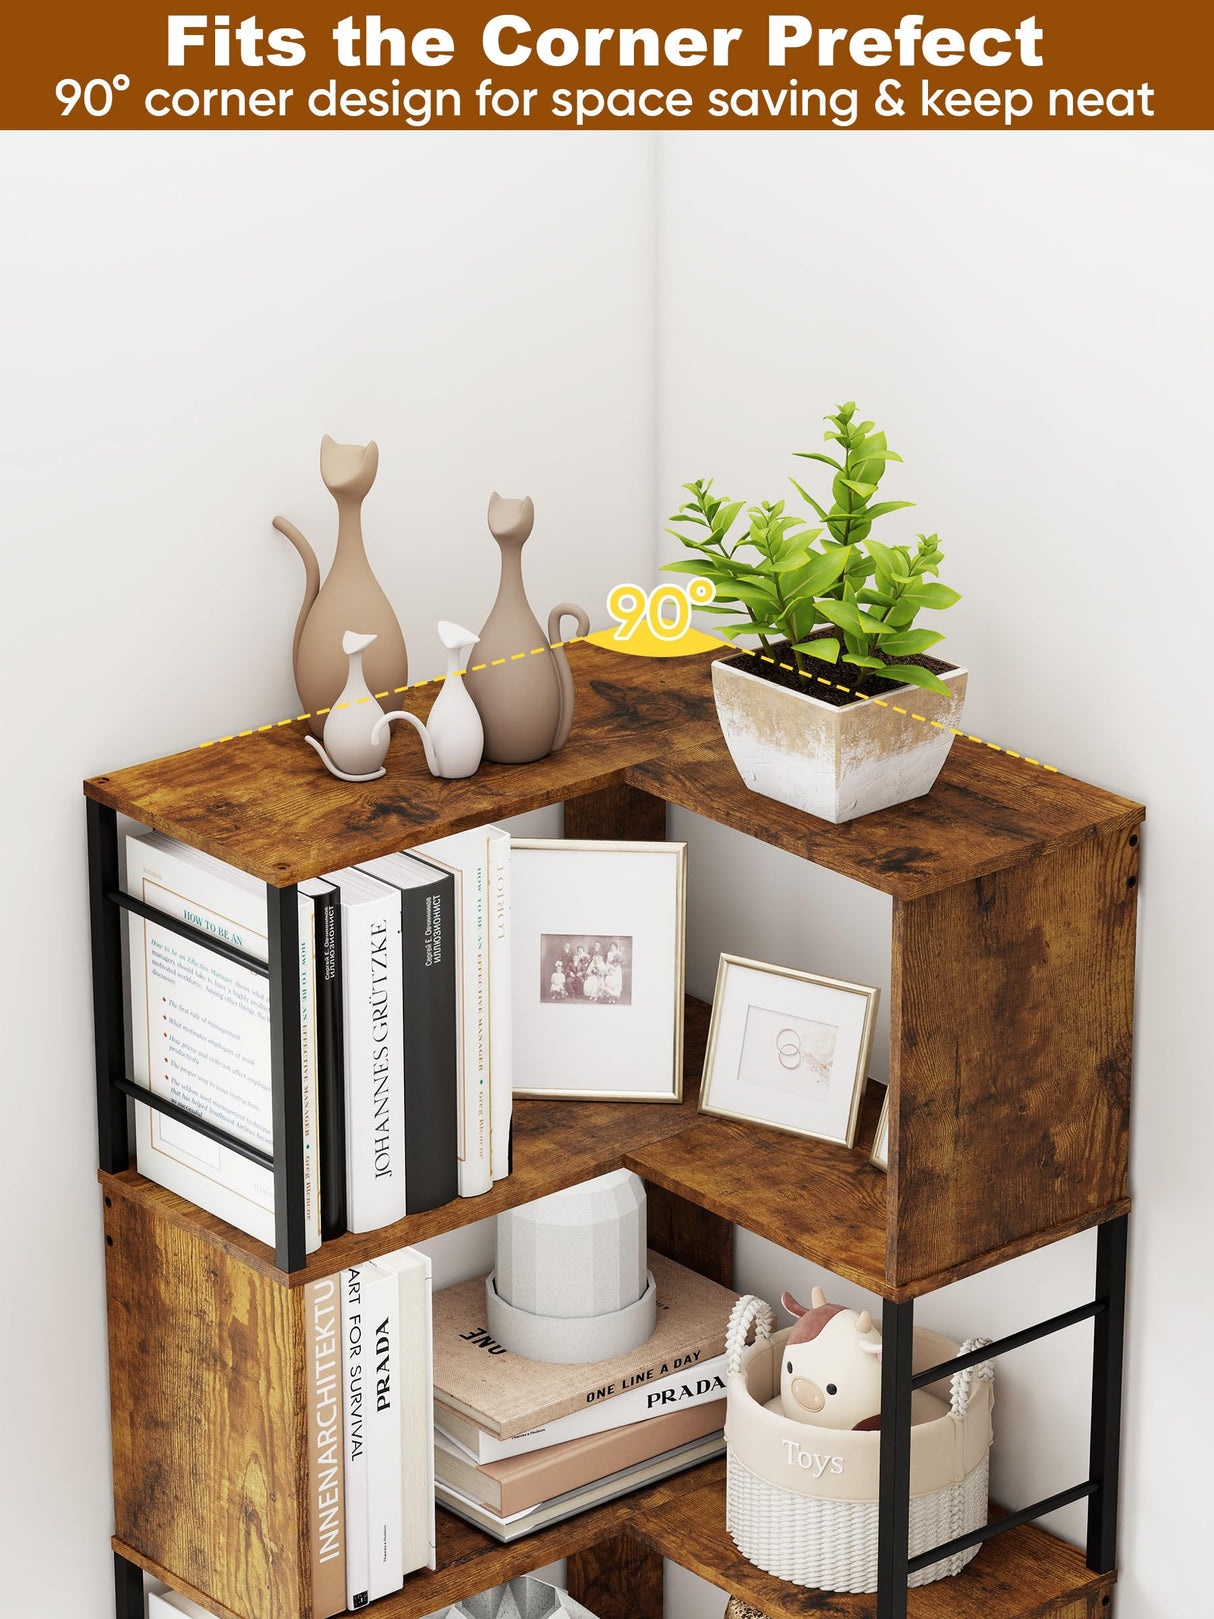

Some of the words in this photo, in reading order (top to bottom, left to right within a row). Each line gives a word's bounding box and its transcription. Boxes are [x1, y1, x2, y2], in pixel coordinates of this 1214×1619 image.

[184, 909, 202, 927] HOW
[205, 920, 216, 933] TO
[219, 926, 228, 940] BE
[231, 933, 242, 946] AN
[369, 919, 388, 1043] GRÜTZKE
[373, 1046, 392, 1179] JOHANNES
[348, 1268, 360, 1304] ART
[349, 1314, 362, 1359] FOR
[376, 1316, 391, 1412] PRADA
[586, 1384, 615, 1403] ONE
[622, 1369, 654, 1390] LINE
[660, 1363, 669, 1374] A
[673, 1350, 701, 1369] DAY
[350, 1365, 364, 1461] SURVIVAL
[647, 1375, 726, 1409] PRADA
[314, 1279, 340, 1563] INNENARCHITEKTU
[782, 1439, 845, 1477] Toys
